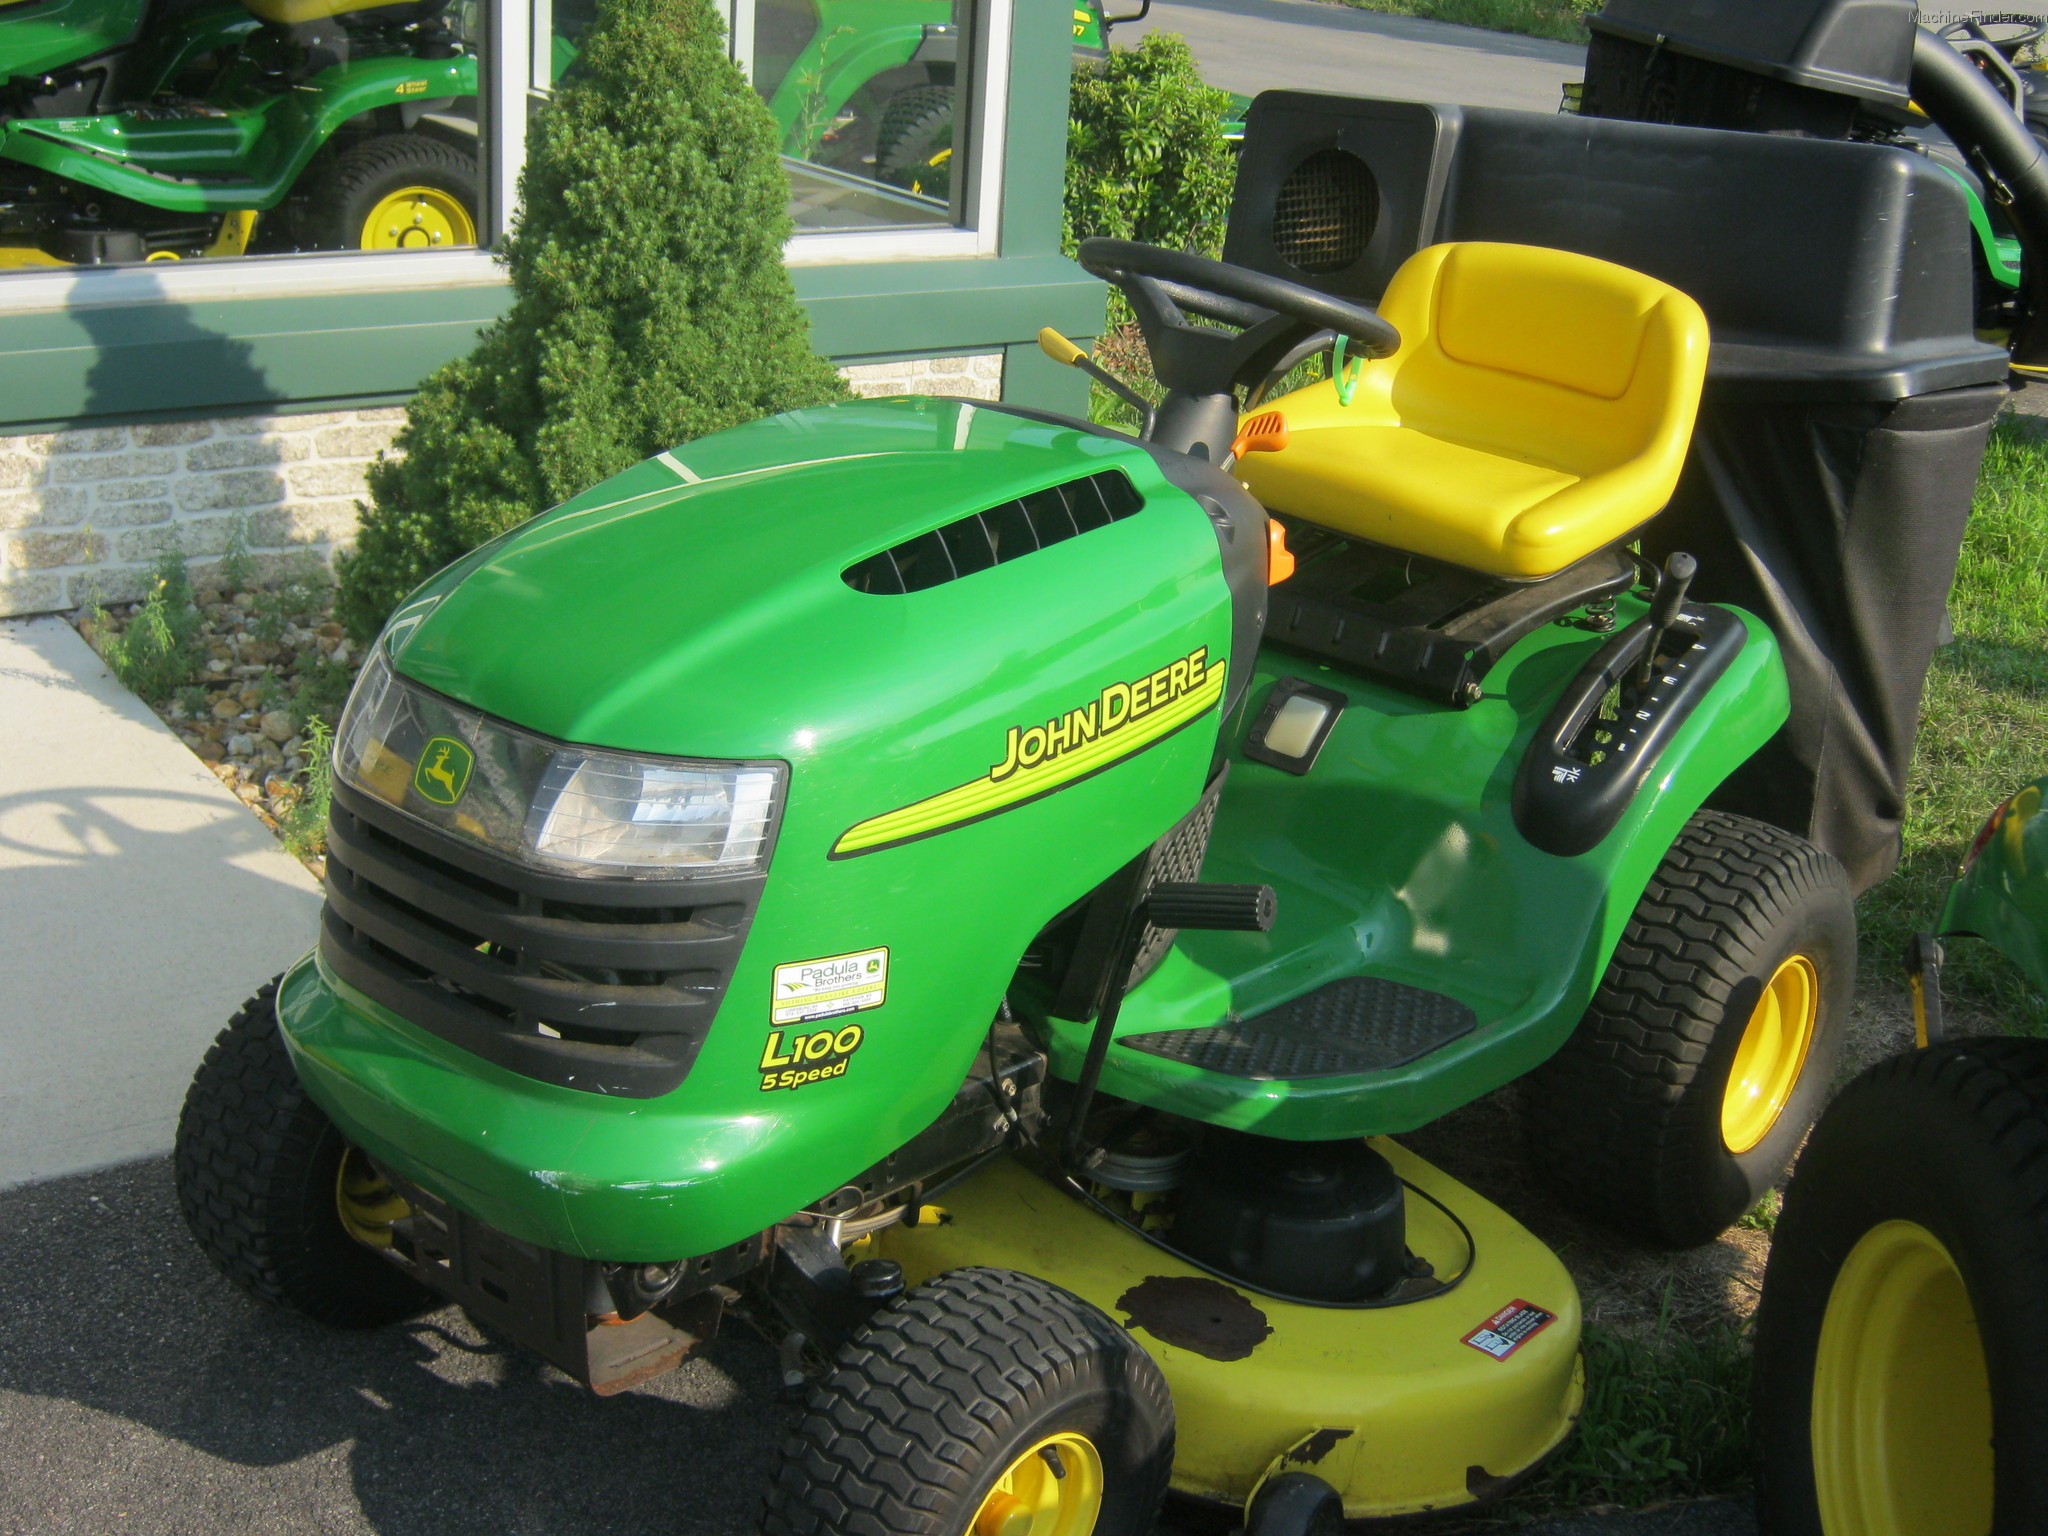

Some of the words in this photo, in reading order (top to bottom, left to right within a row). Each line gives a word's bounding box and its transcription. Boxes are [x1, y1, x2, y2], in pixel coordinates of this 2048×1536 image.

[395, 83, 404, 94] 4
[990, 699, 1100, 783] JOHN
[1100, 644, 1208, 737] DEERE
[801, 961, 858, 981] Padula
[815, 972, 862, 988] Brothers
[759, 1024, 864, 1073] L100
[760, 1072, 778, 1092] 5
[778, 1057, 849, 1090] Speed
